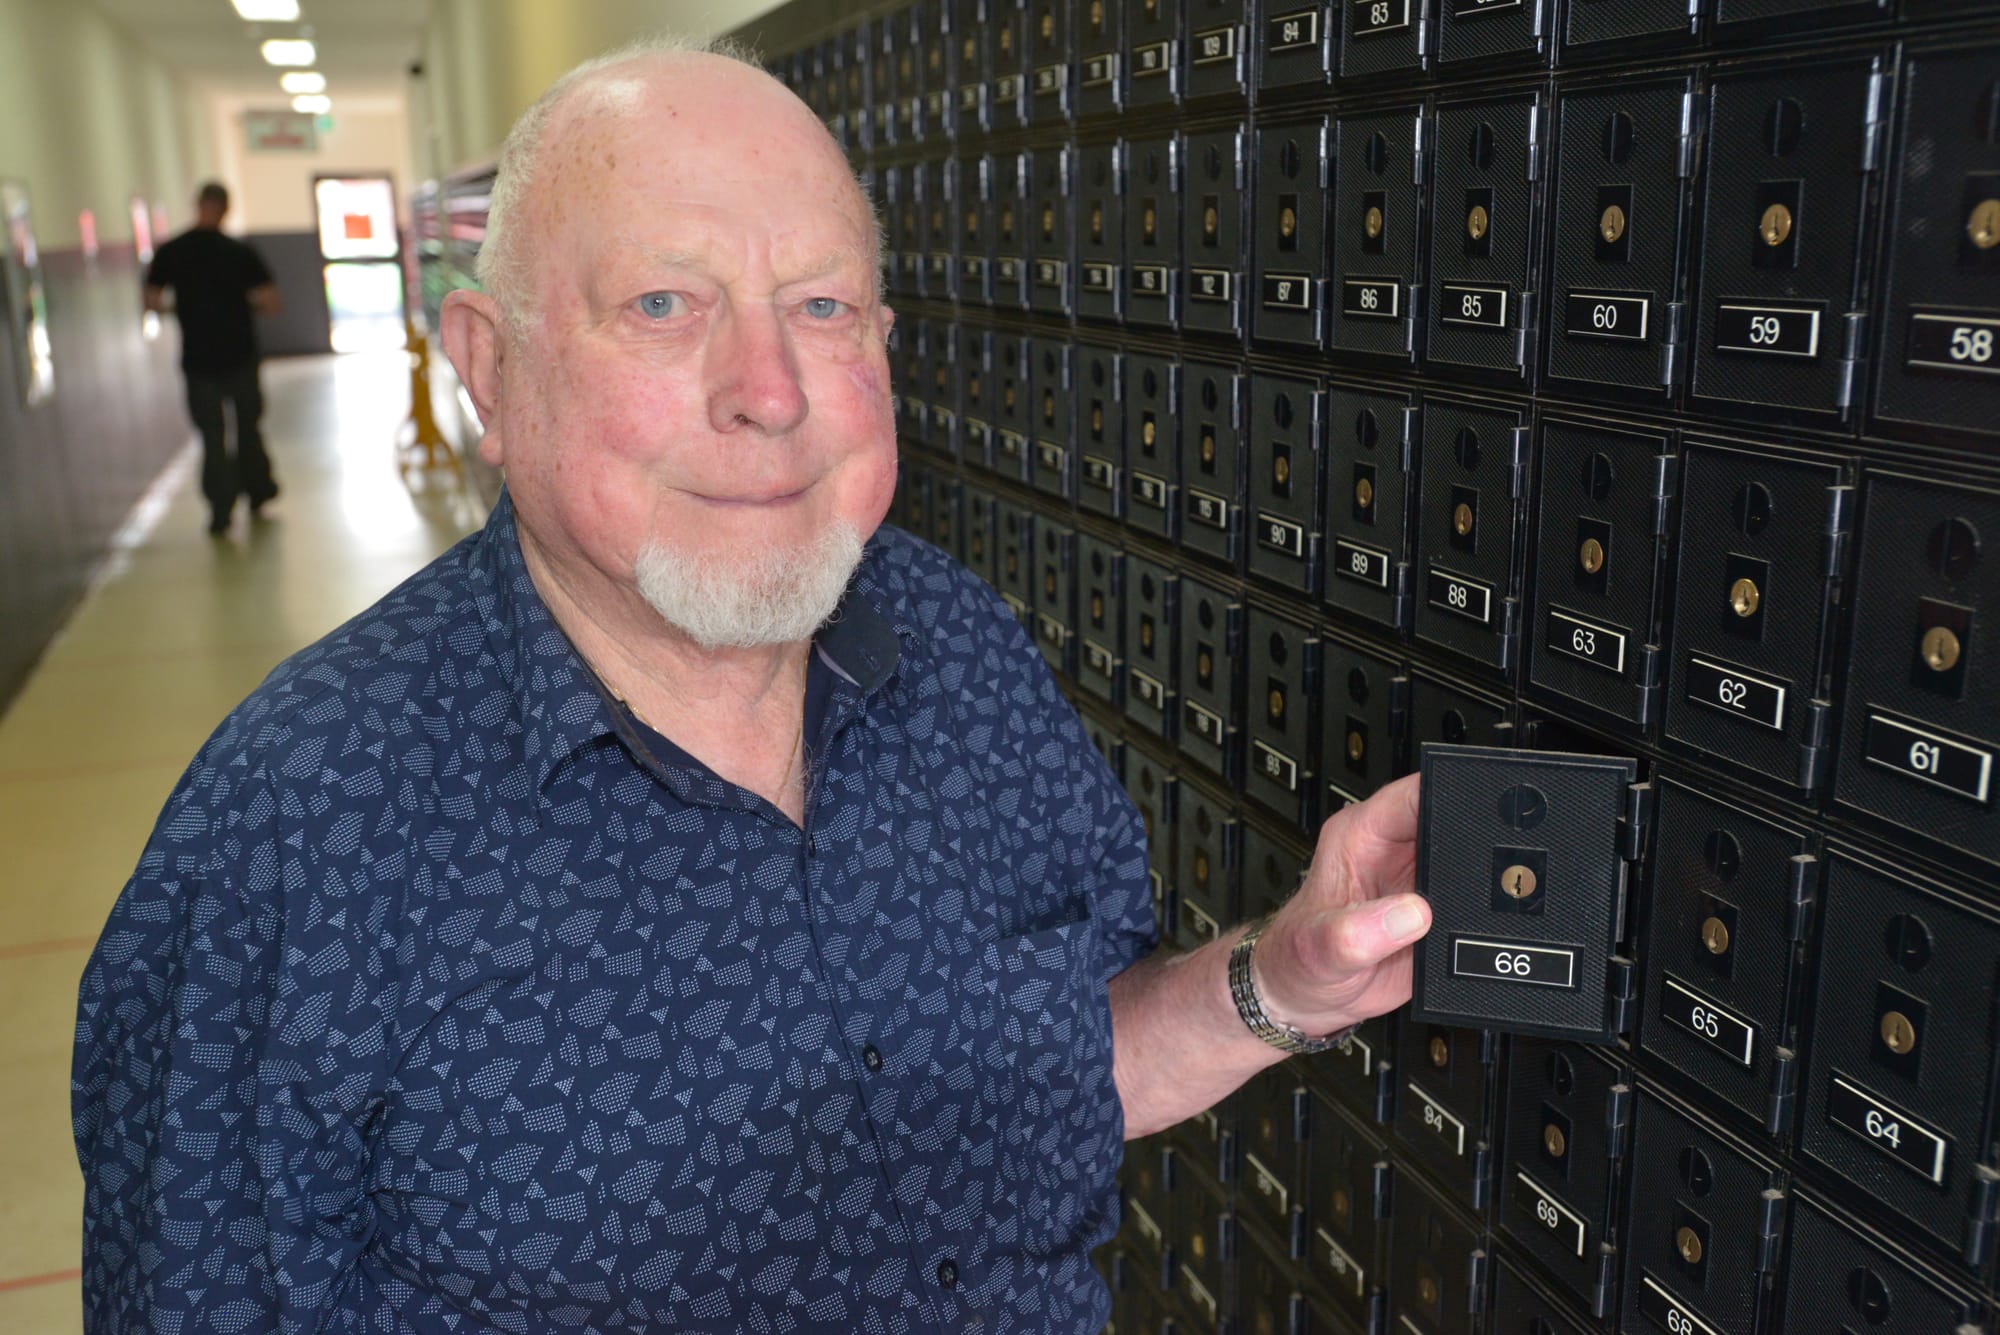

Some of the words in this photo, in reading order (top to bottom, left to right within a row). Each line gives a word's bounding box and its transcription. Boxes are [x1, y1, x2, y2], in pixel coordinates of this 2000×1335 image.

[1371, 2, 1389, 24] 83
[1283, 22, 1300, 42] 84
[1278, 281, 1292, 301] 87
[1361, 288, 1378, 309] 86
[1463, 295, 1482, 318] 85
[1594, 305, 1616, 328] 60
[1750, 317, 1779, 344] 59
[1950, 328, 1993, 362] 58
[1271, 526, 1286, 546] 90
[1352, 552, 1368, 575] 89
[1448, 584, 1467, 608] 88
[1573, 629, 1596, 655] 63
[1719, 678, 1747, 710] 62
[1266, 753, 1281, 776] 93
[1910, 741, 1941, 774] 61
[1495, 953, 1531, 976] 66
[1692, 1006, 1720, 1038] 65
[1424, 1104, 1443, 1133] 94
[1866, 1110, 1901, 1149] 64
[1537, 1199, 1559, 1229] 69
[1668, 1309, 1693, 1335] 68
